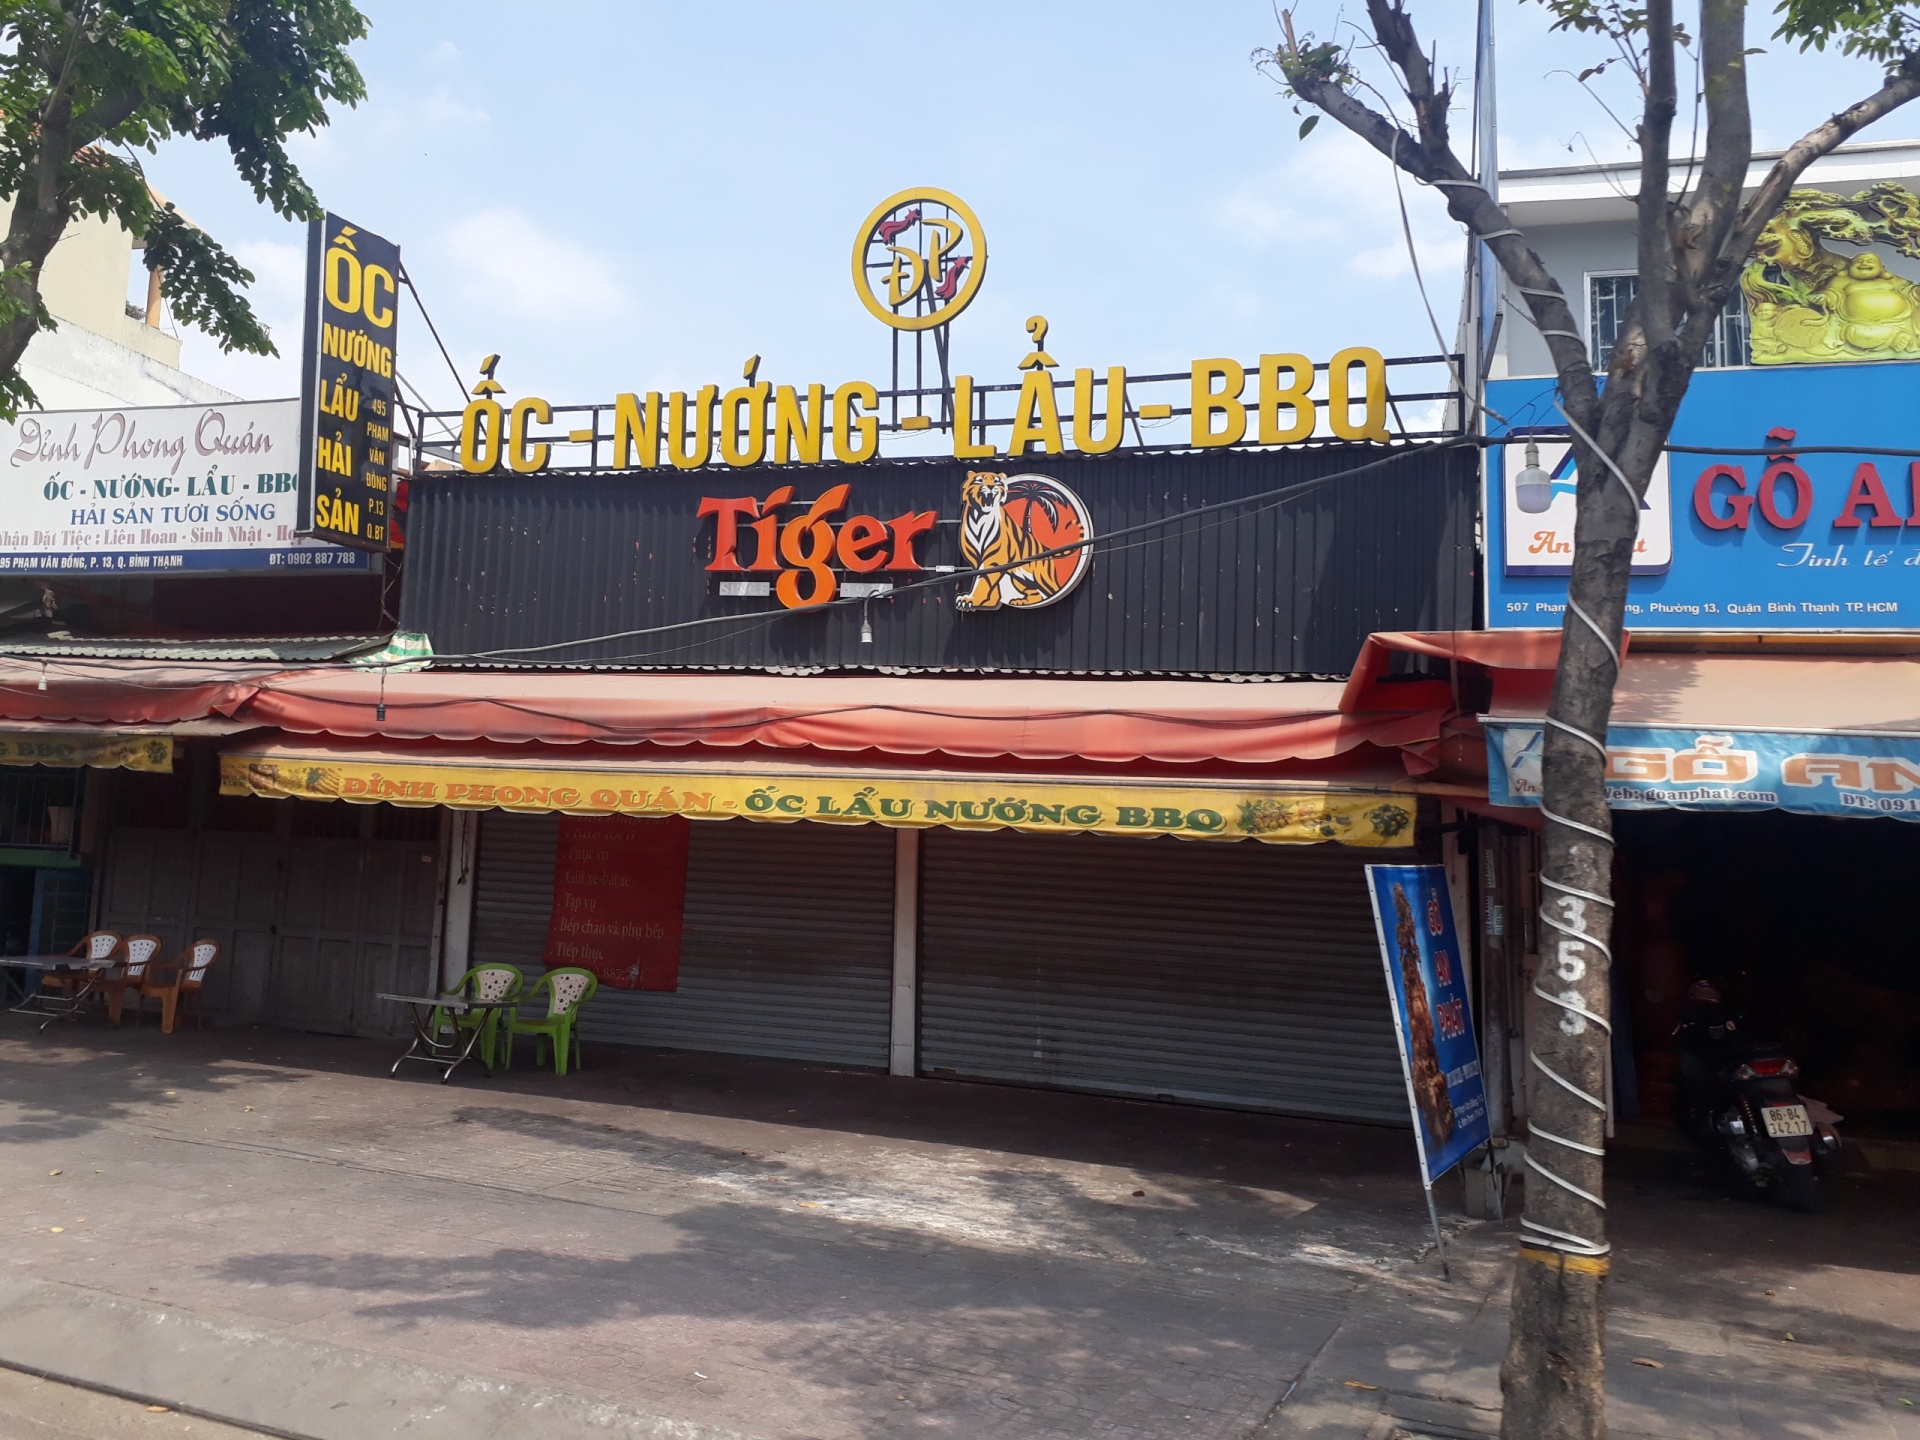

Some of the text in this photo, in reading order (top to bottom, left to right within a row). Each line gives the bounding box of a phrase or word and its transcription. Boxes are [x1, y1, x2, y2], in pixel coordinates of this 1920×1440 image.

[324, 225, 395, 329] ỐC
[322, 322, 392, 379] NƯỚNG
[319, 372, 359, 422] LẨU
[460, 354, 553, 475] ỐC
[612, 354, 880, 471] NƯỚNG
[953, 314, 1126, 458] LẨU
[1191, 346, 1391, 448] BBQ
[371, 398, 387, 417] 495
[83, 412, 187, 476] Phong
[195, 408, 274, 456] Quán
[366, 421, 389, 442] PHẠM
[317, 430, 352, 478] HẢI
[368, 446, 385, 466] VĂN
[43, 471, 74, 501] ỐC
[186, 464, 236, 496] LẨU
[1694, 426, 1920, 530] GỖ A
[70, 496, 276, 526] HẢI SẢN TƯƠI SỐNG
[315, 487, 359, 536] SẢN
[368, 497, 384, 516] P.13
[0, 530, 29, 550] hận
[104, 528, 136, 545] Liên
[139, 528, 178, 545] Hoan
[190, 525, 223, 543] Sinh
[227, 525, 263, 546] Nhật
[366, 522, 385, 542] Q.BT
[1528, 531, 1572, 554] An
[269, 552, 356, 565] ĐT: 0902 887 788
[696, 483, 939, 612] Tiger
[1776, 542, 1850, 567] Tinh
[1863, 549, 1894, 567] tế
[12, 556, 39, 572] PHẠM
[40, 554, 60, 569] VĂN
[129, 554, 150, 568] BÌNH
[153, 554, 183, 570] THẠNH
[720, 582, 769, 595] SINCE
[1506, 602, 1528, 612] 507
[1650, 602, 1700, 615] Phường
[1703, 603, 1720, 613] 13,
[1727, 602, 1761, 616] Quận
[1767, 602, 1796, 613] Bình
[1800, 602, 1839, 615] Thạnh
[1867, 602, 1898, 613] HCM
[1604, 738, 1748, 783] GỖ
[1515, 778, 1536, 792] An
[1646, 788, 1778, 803] goanphat.com
[341, 772, 437, 800] ĐỈNH
[445, 783, 580, 807] PHONG
[590, 786, 716, 812] QUÁN
[745, 785, 807, 815] ỐC
[814, 786, 916, 820] LẨU
[923, 796, 1105, 829] NƯỚNG
[1115, 806, 1230, 835] BBQ
[1880, 798, 1920, 811] 091
[564, 892, 582, 912] Tạp
[559, 916, 580, 936] Bếp
[622, 920, 642, 941] phụ
[556, 941, 579, 962] Tiếp
[1769, 1108, 1801, 1121] 86-B4
[1769, 1120, 1807, 1134] 342.17
